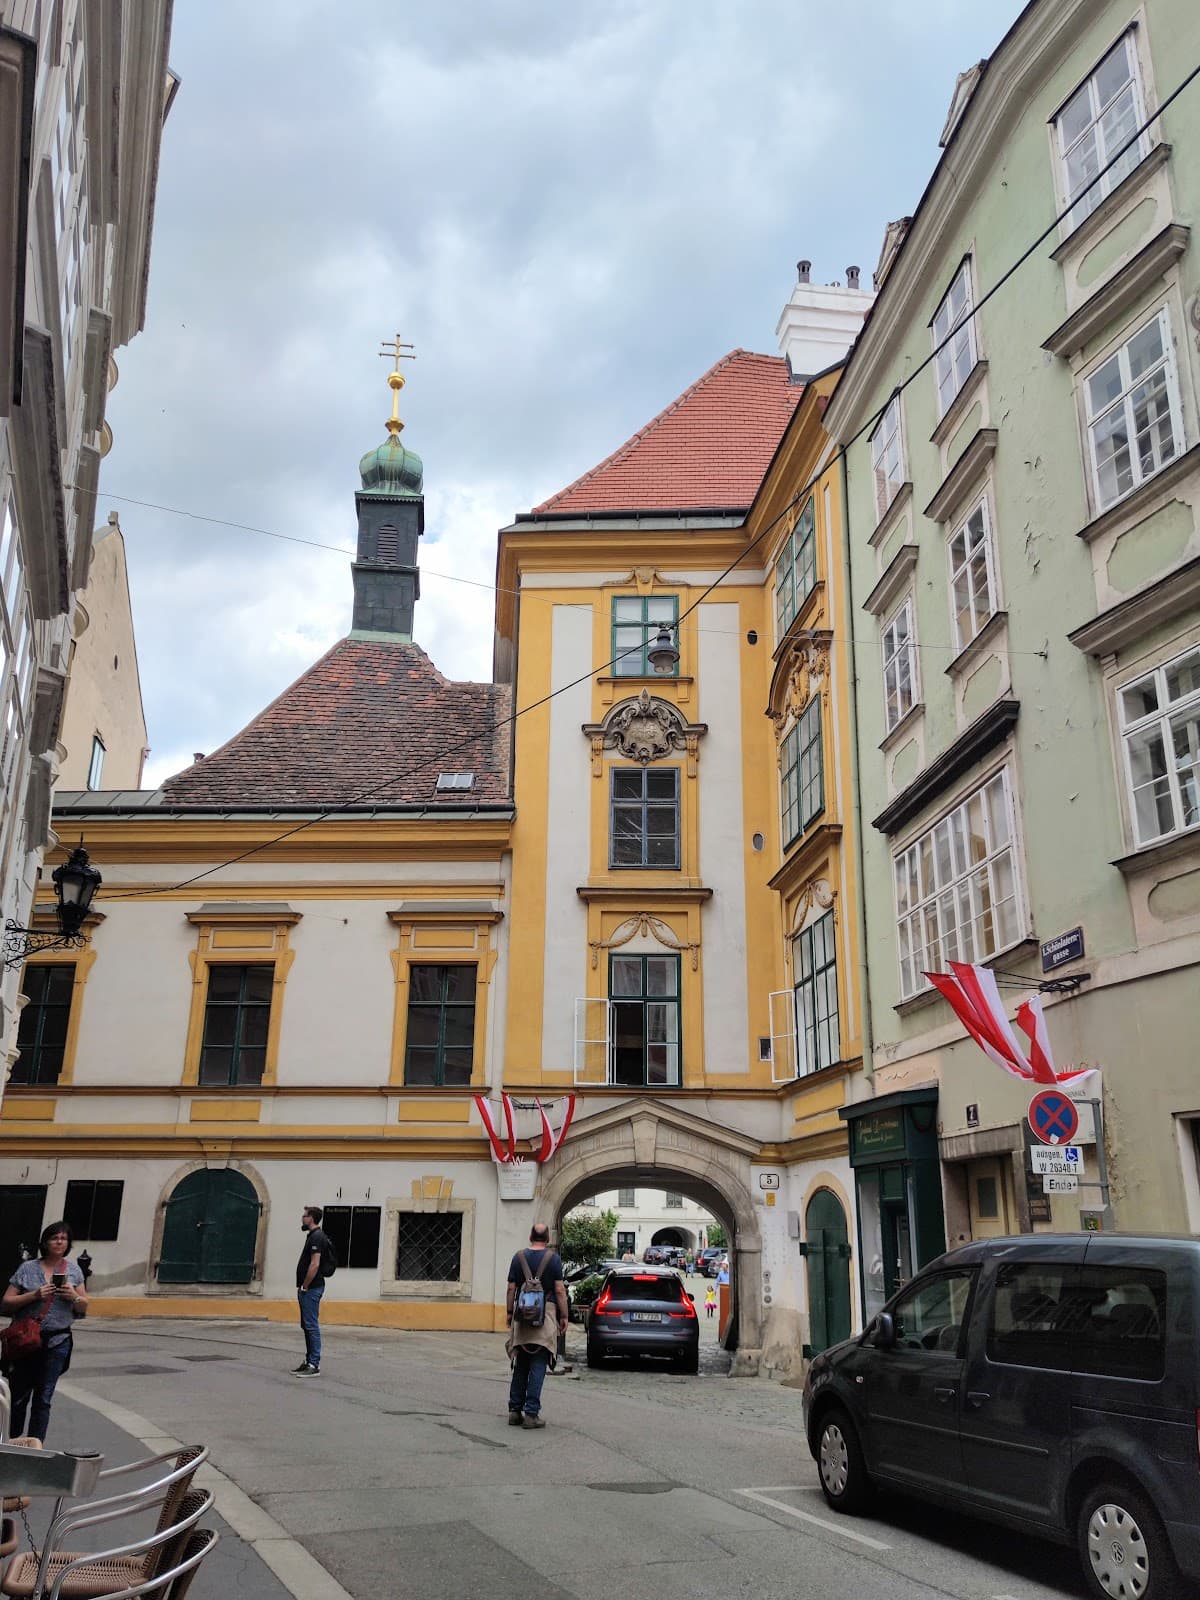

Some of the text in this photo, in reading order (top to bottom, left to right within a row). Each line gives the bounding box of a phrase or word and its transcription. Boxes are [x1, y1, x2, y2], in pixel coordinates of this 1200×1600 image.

[1052, 948, 1070, 963] gasse
[1039, 1162, 1047, 1172] W
[766, 1175, 772, 1185] 5
[1049, 1179, 1072, 1191] Ende
